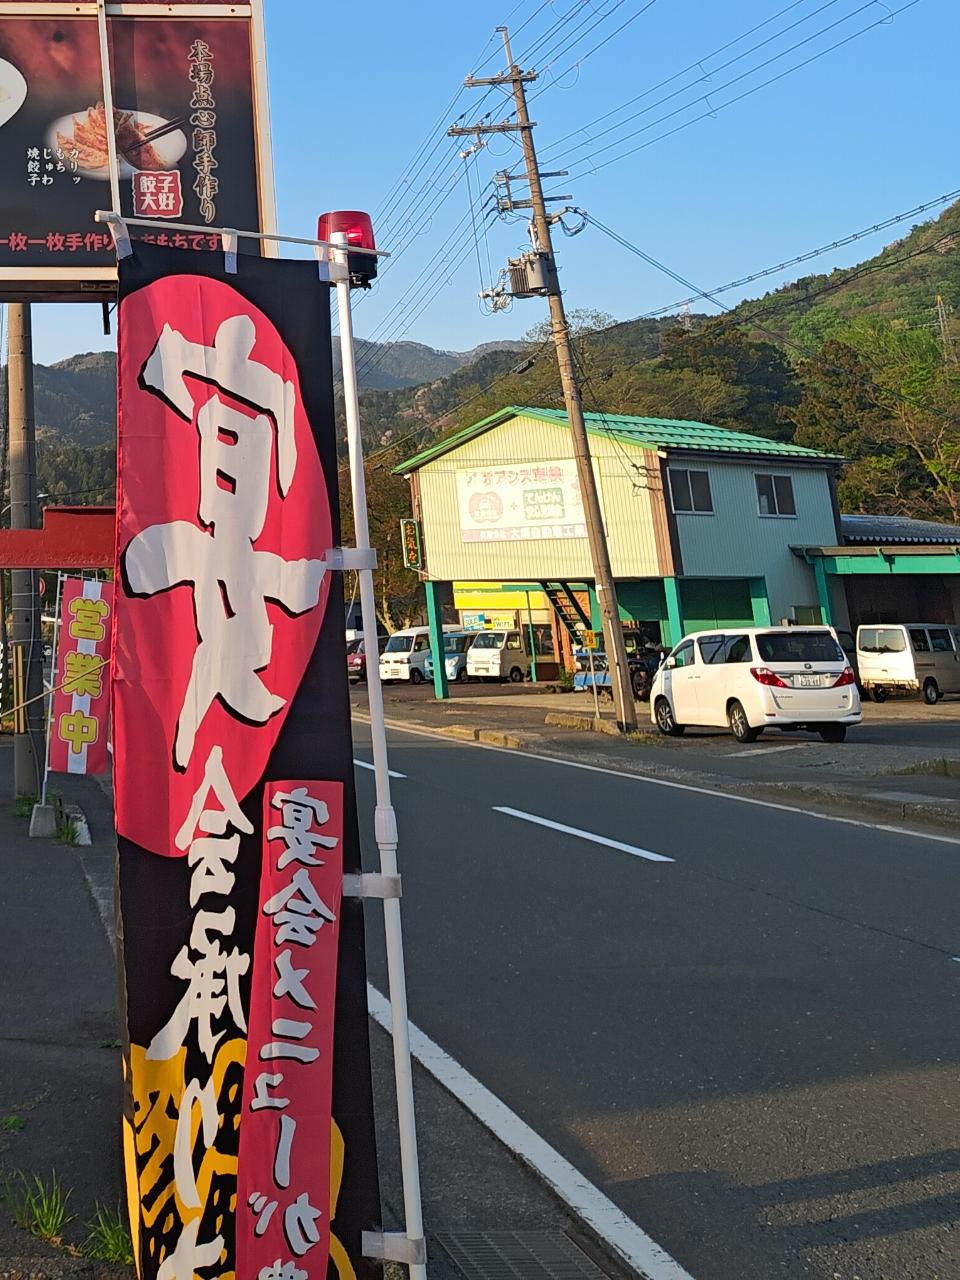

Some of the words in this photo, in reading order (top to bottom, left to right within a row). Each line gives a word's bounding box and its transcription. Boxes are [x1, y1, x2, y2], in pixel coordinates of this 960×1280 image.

[187, 39, 219, 224] 本場点心師手作り
[26, 147, 41, 187] 焼餃子
[55, 148, 67, 173] もち
[69, 148, 82, 185] カリッ
[140, 175, 175, 194] 餃子
[140, 192, 176, 211] 大好
[59, 597, 110, 755] 営業中
